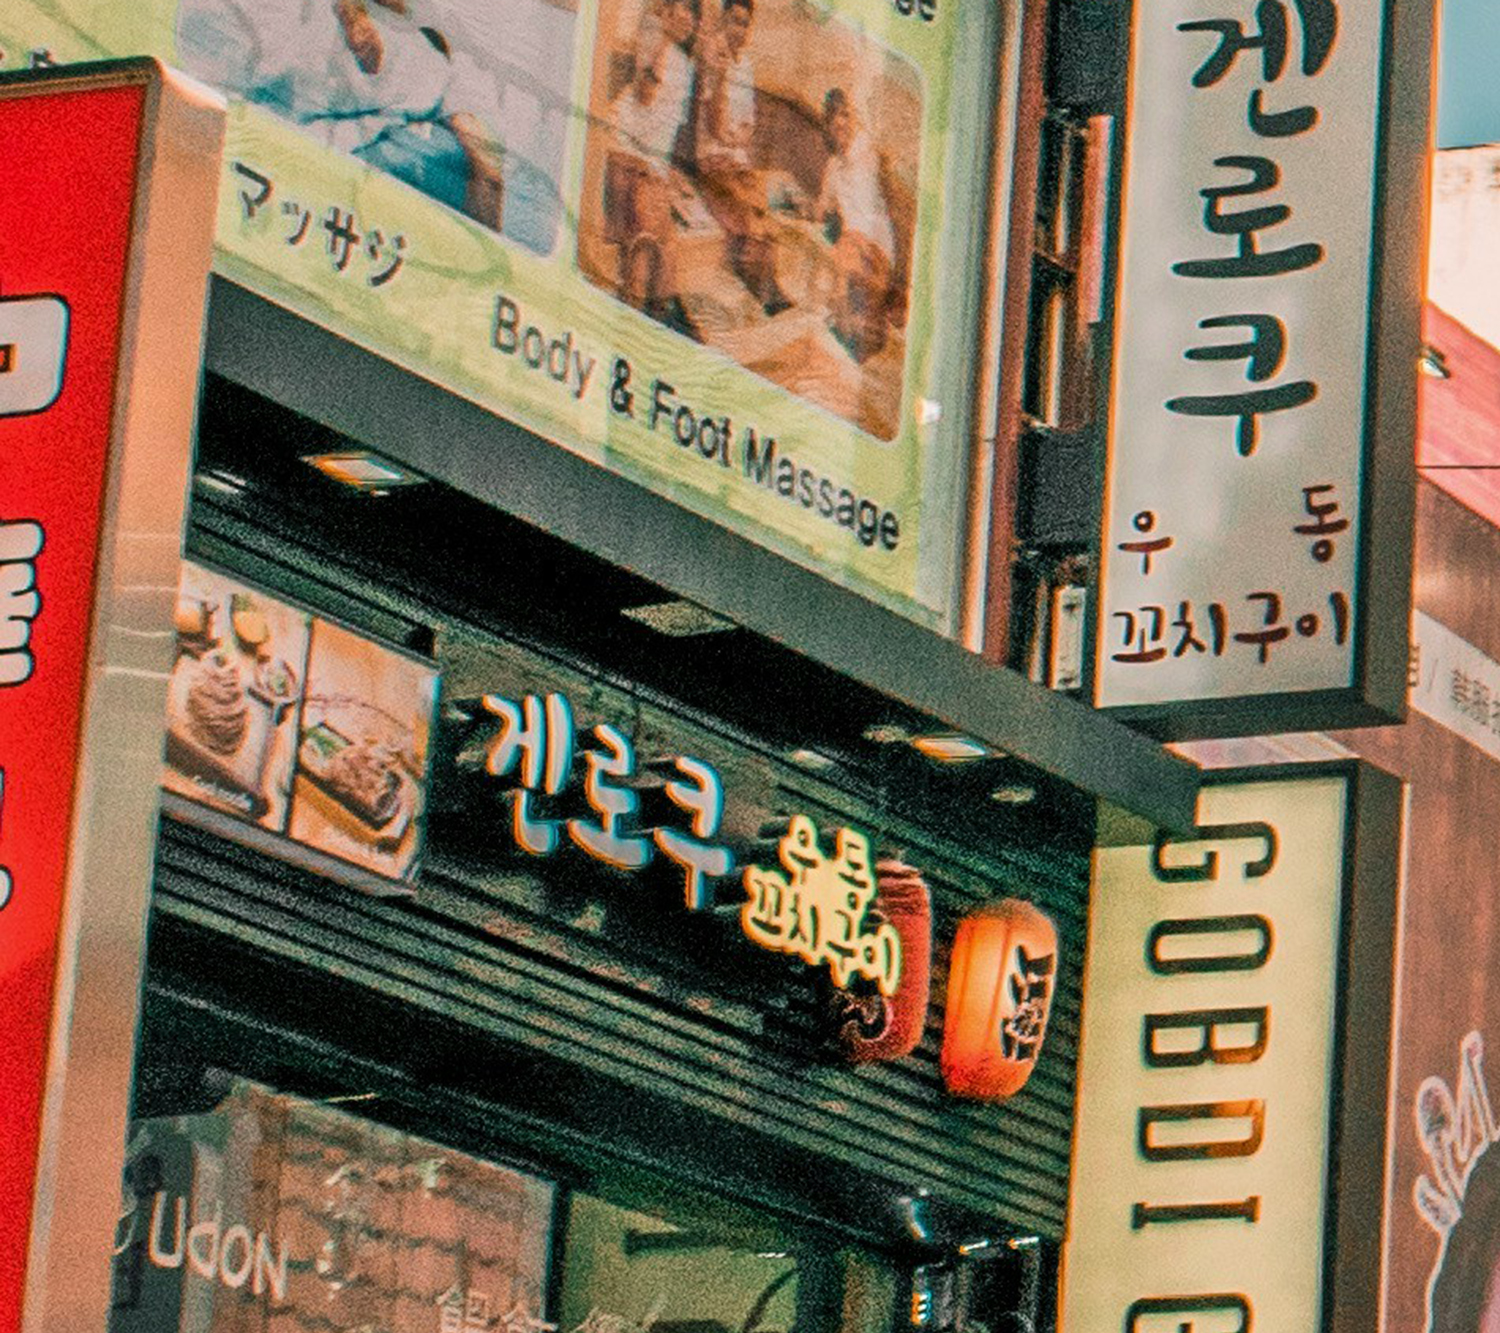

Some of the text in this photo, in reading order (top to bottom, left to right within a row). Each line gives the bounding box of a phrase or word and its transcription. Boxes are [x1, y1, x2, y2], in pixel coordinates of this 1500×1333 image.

[231, 161, 408, 288] マッサジ
[490, 292, 904, 554] Body & Foot Massage
[1111, 592, 1350, 664] 꼬치구이
[482, 690, 736, 912] 겐로쿠
[1136, 819, 1277, 1230] GOBDI
